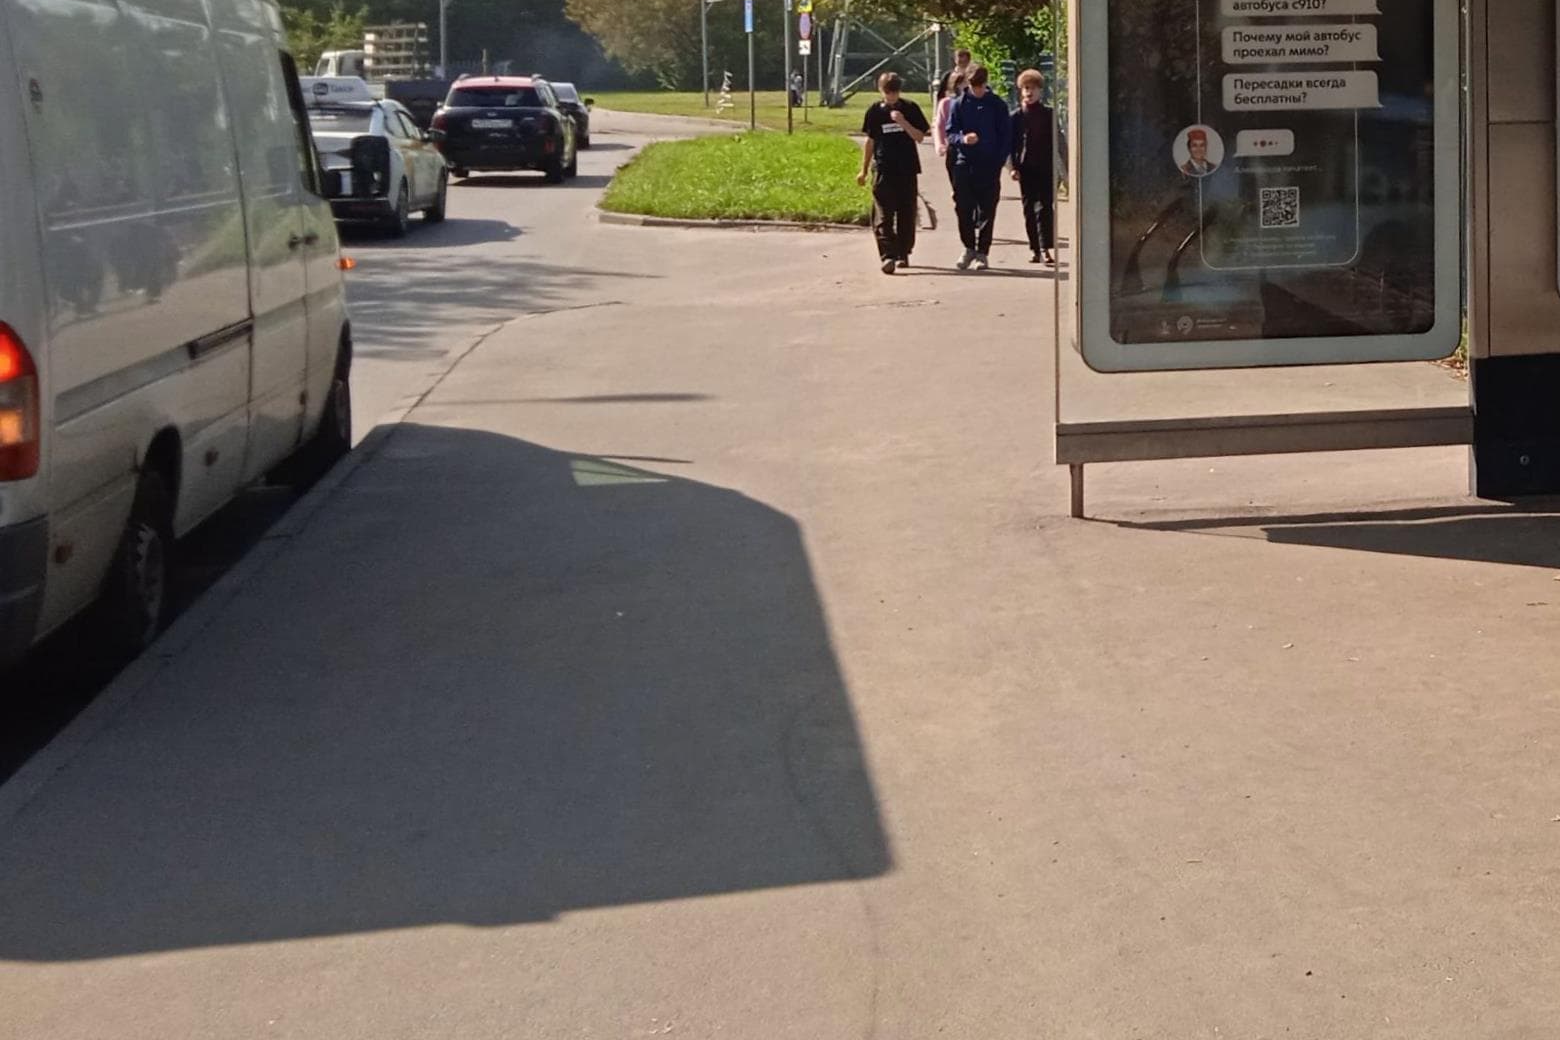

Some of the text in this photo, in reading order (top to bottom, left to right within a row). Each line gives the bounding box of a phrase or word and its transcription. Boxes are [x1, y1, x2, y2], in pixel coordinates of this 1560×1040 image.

[1233, 0, 1289, 12] автобуса
[1233, 30, 1362, 44] Почему мой автобус
[1233, 45, 1330, 60] проехал мимо?
[1234, 78, 1347, 92] Пересадки всегда
[1234, 93, 1308, 106] бесплатны?
